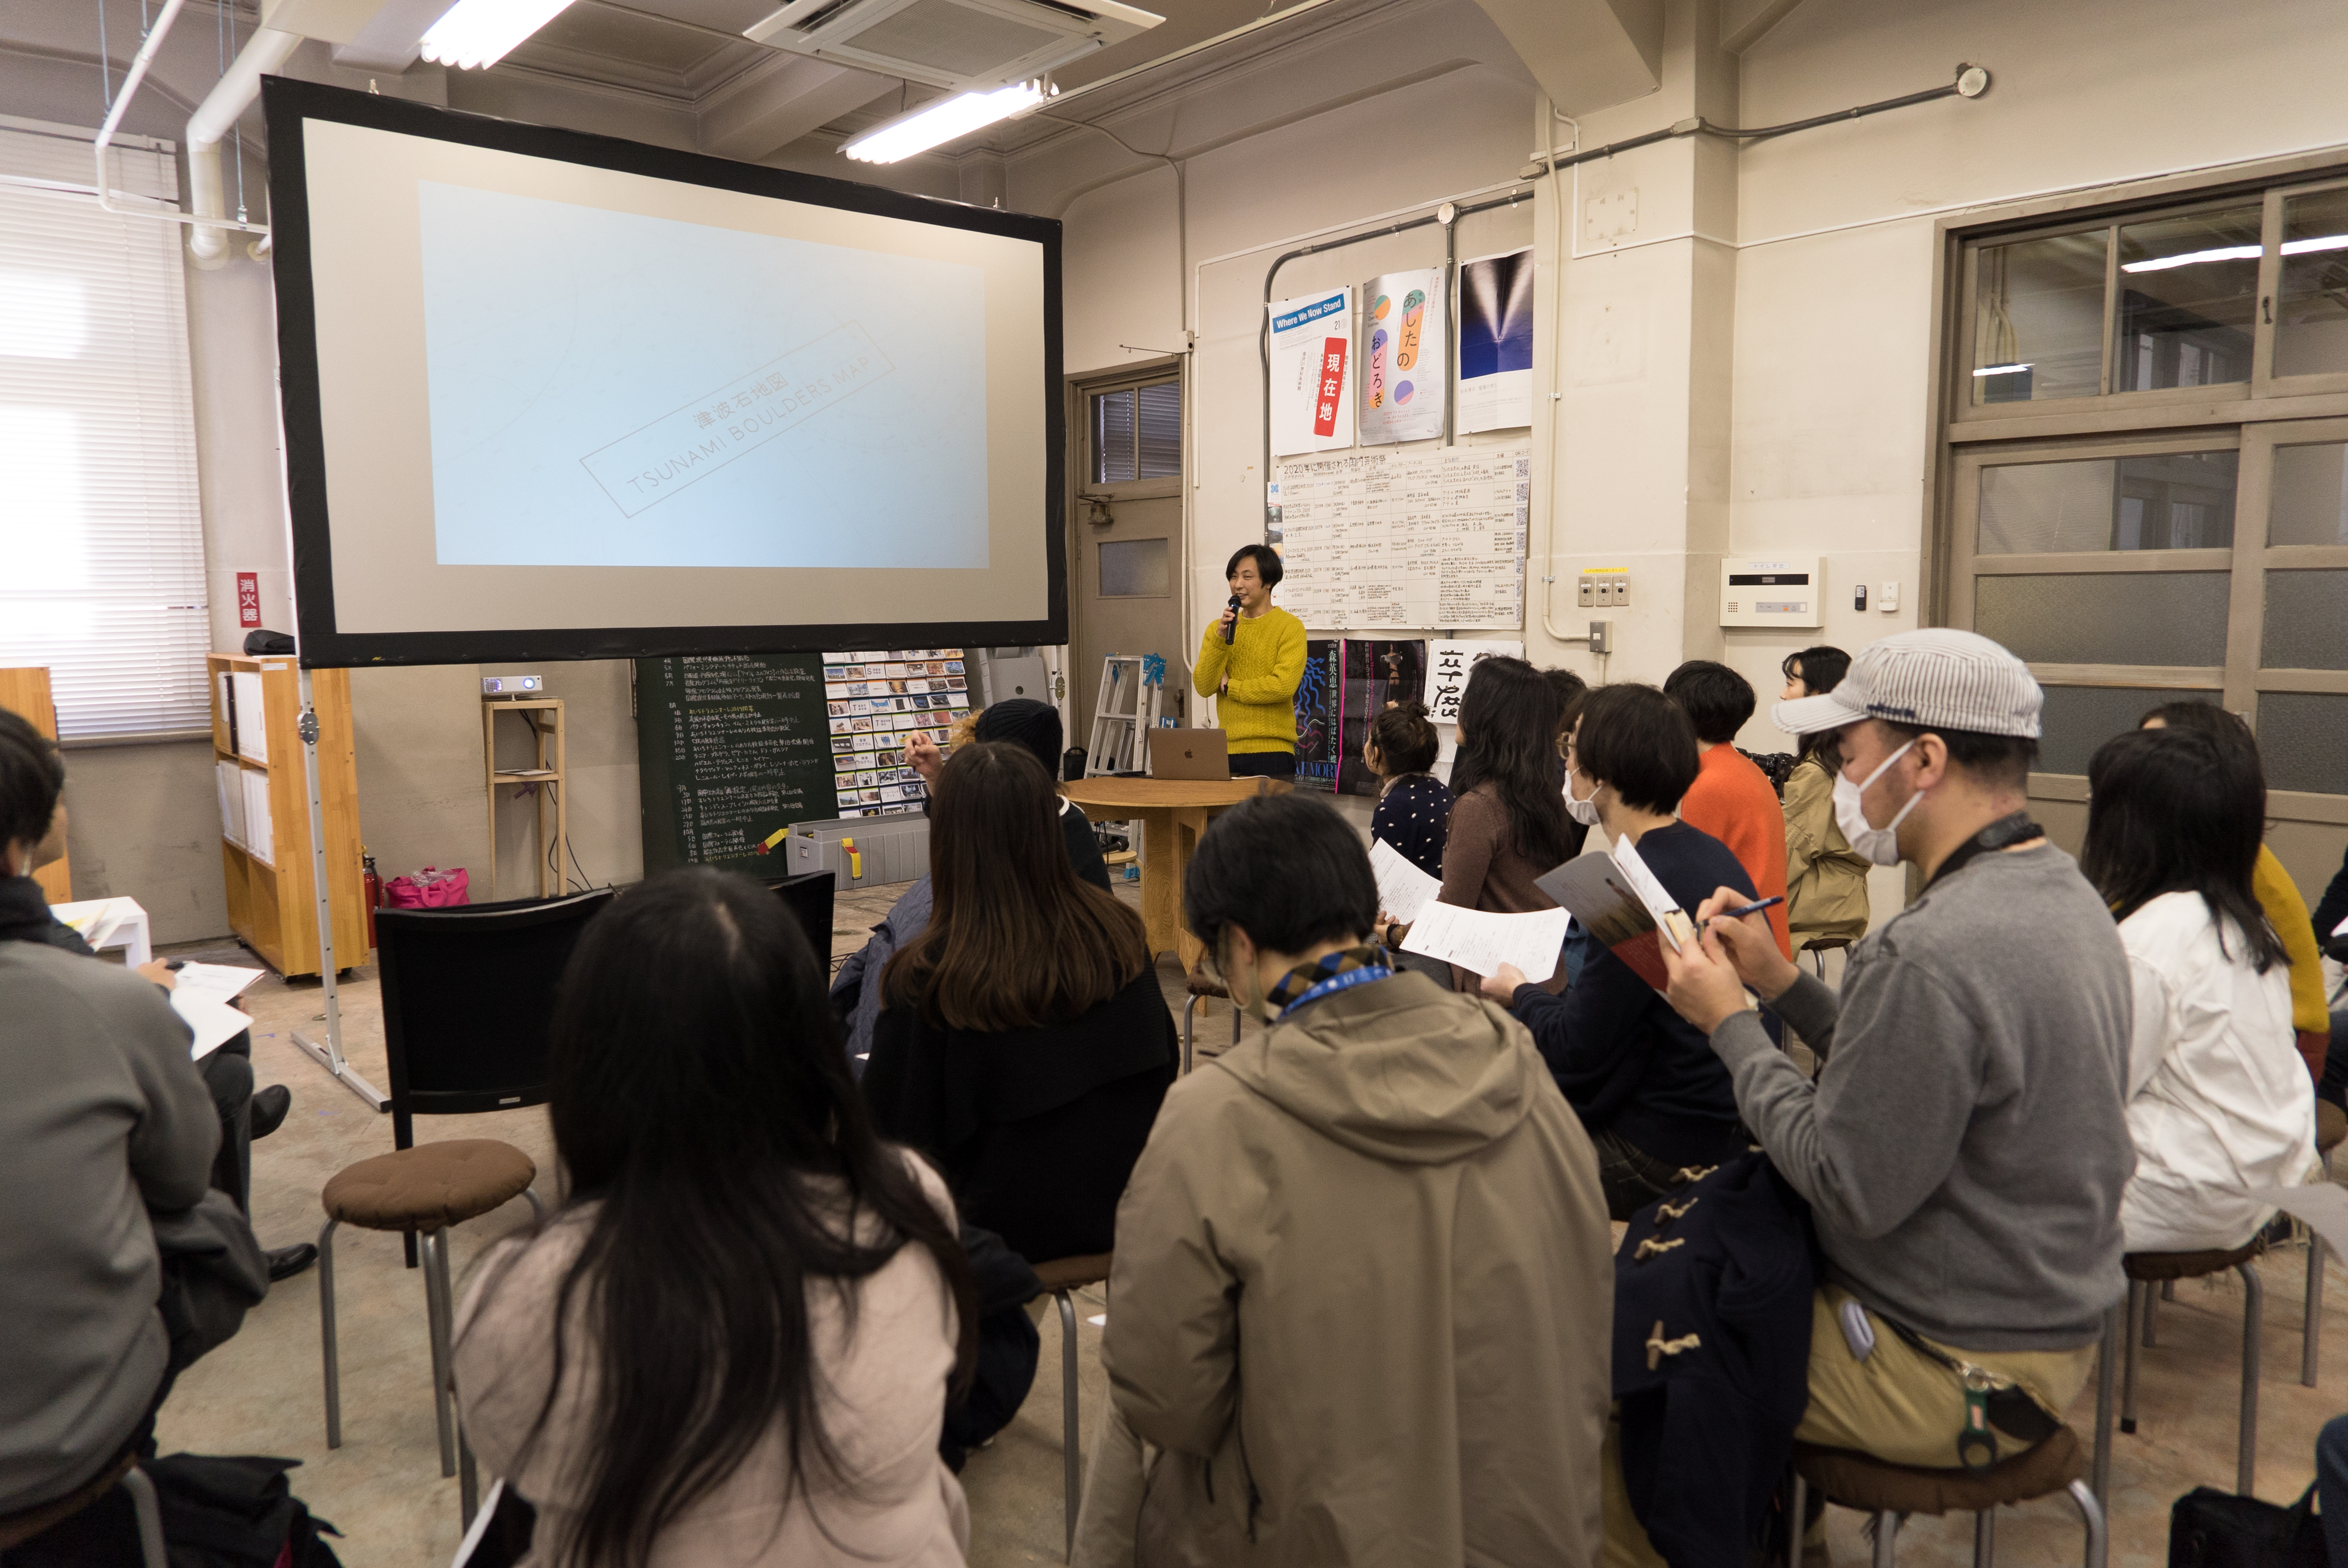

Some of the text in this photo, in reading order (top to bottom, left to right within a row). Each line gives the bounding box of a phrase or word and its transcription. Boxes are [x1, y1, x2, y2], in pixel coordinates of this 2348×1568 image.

[1276, 316, 1297, 329] Where
[1298, 312, 1307, 322] We
[1307, 307, 1322, 318] Now
[1323, 298, 1341, 313] Stand
[1335, 320, 1341, 330] 21
[1397, 292, 1417, 367] あしたの
[1319, 354, 1340, 421] 現在地
[1372, 336, 1382, 408] おどろき
[626, 355, 871, 494] TSUNAMI BOULDERS MAP
[692, 372, 790, 430] 津波石地図
[1284, 455, 1386, 474] 2020年に開催される国内芸術祭
[240, 579, 258, 621] 消火器
[1309, 762, 1337, 778] MORI
